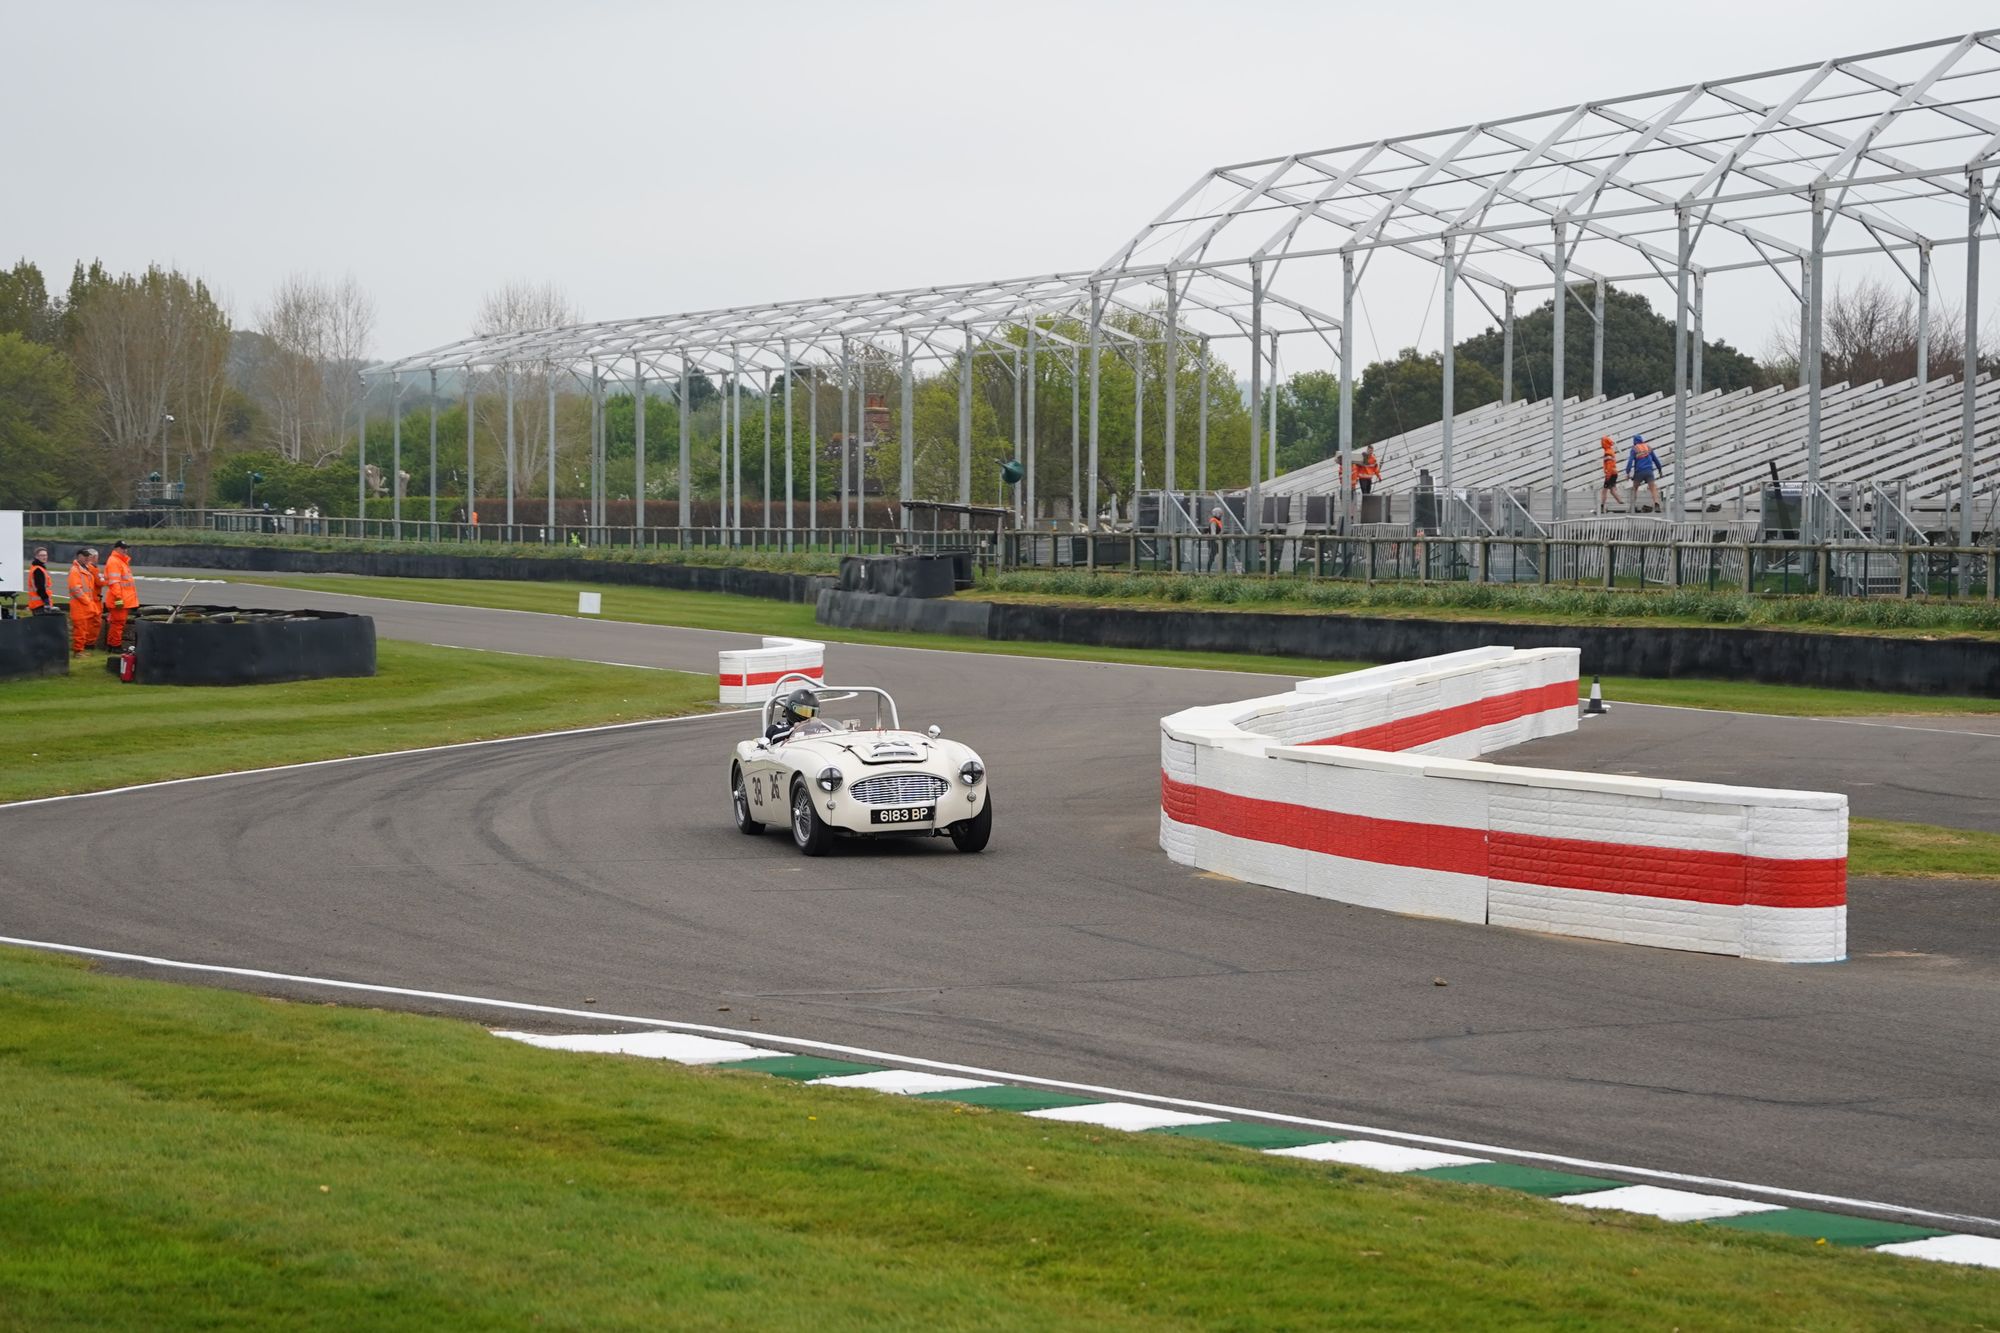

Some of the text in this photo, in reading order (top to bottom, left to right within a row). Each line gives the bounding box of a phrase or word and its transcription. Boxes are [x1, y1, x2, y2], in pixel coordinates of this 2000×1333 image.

[752, 776, 763, 806] 38
[880, 807, 928, 822] 6183 BP
